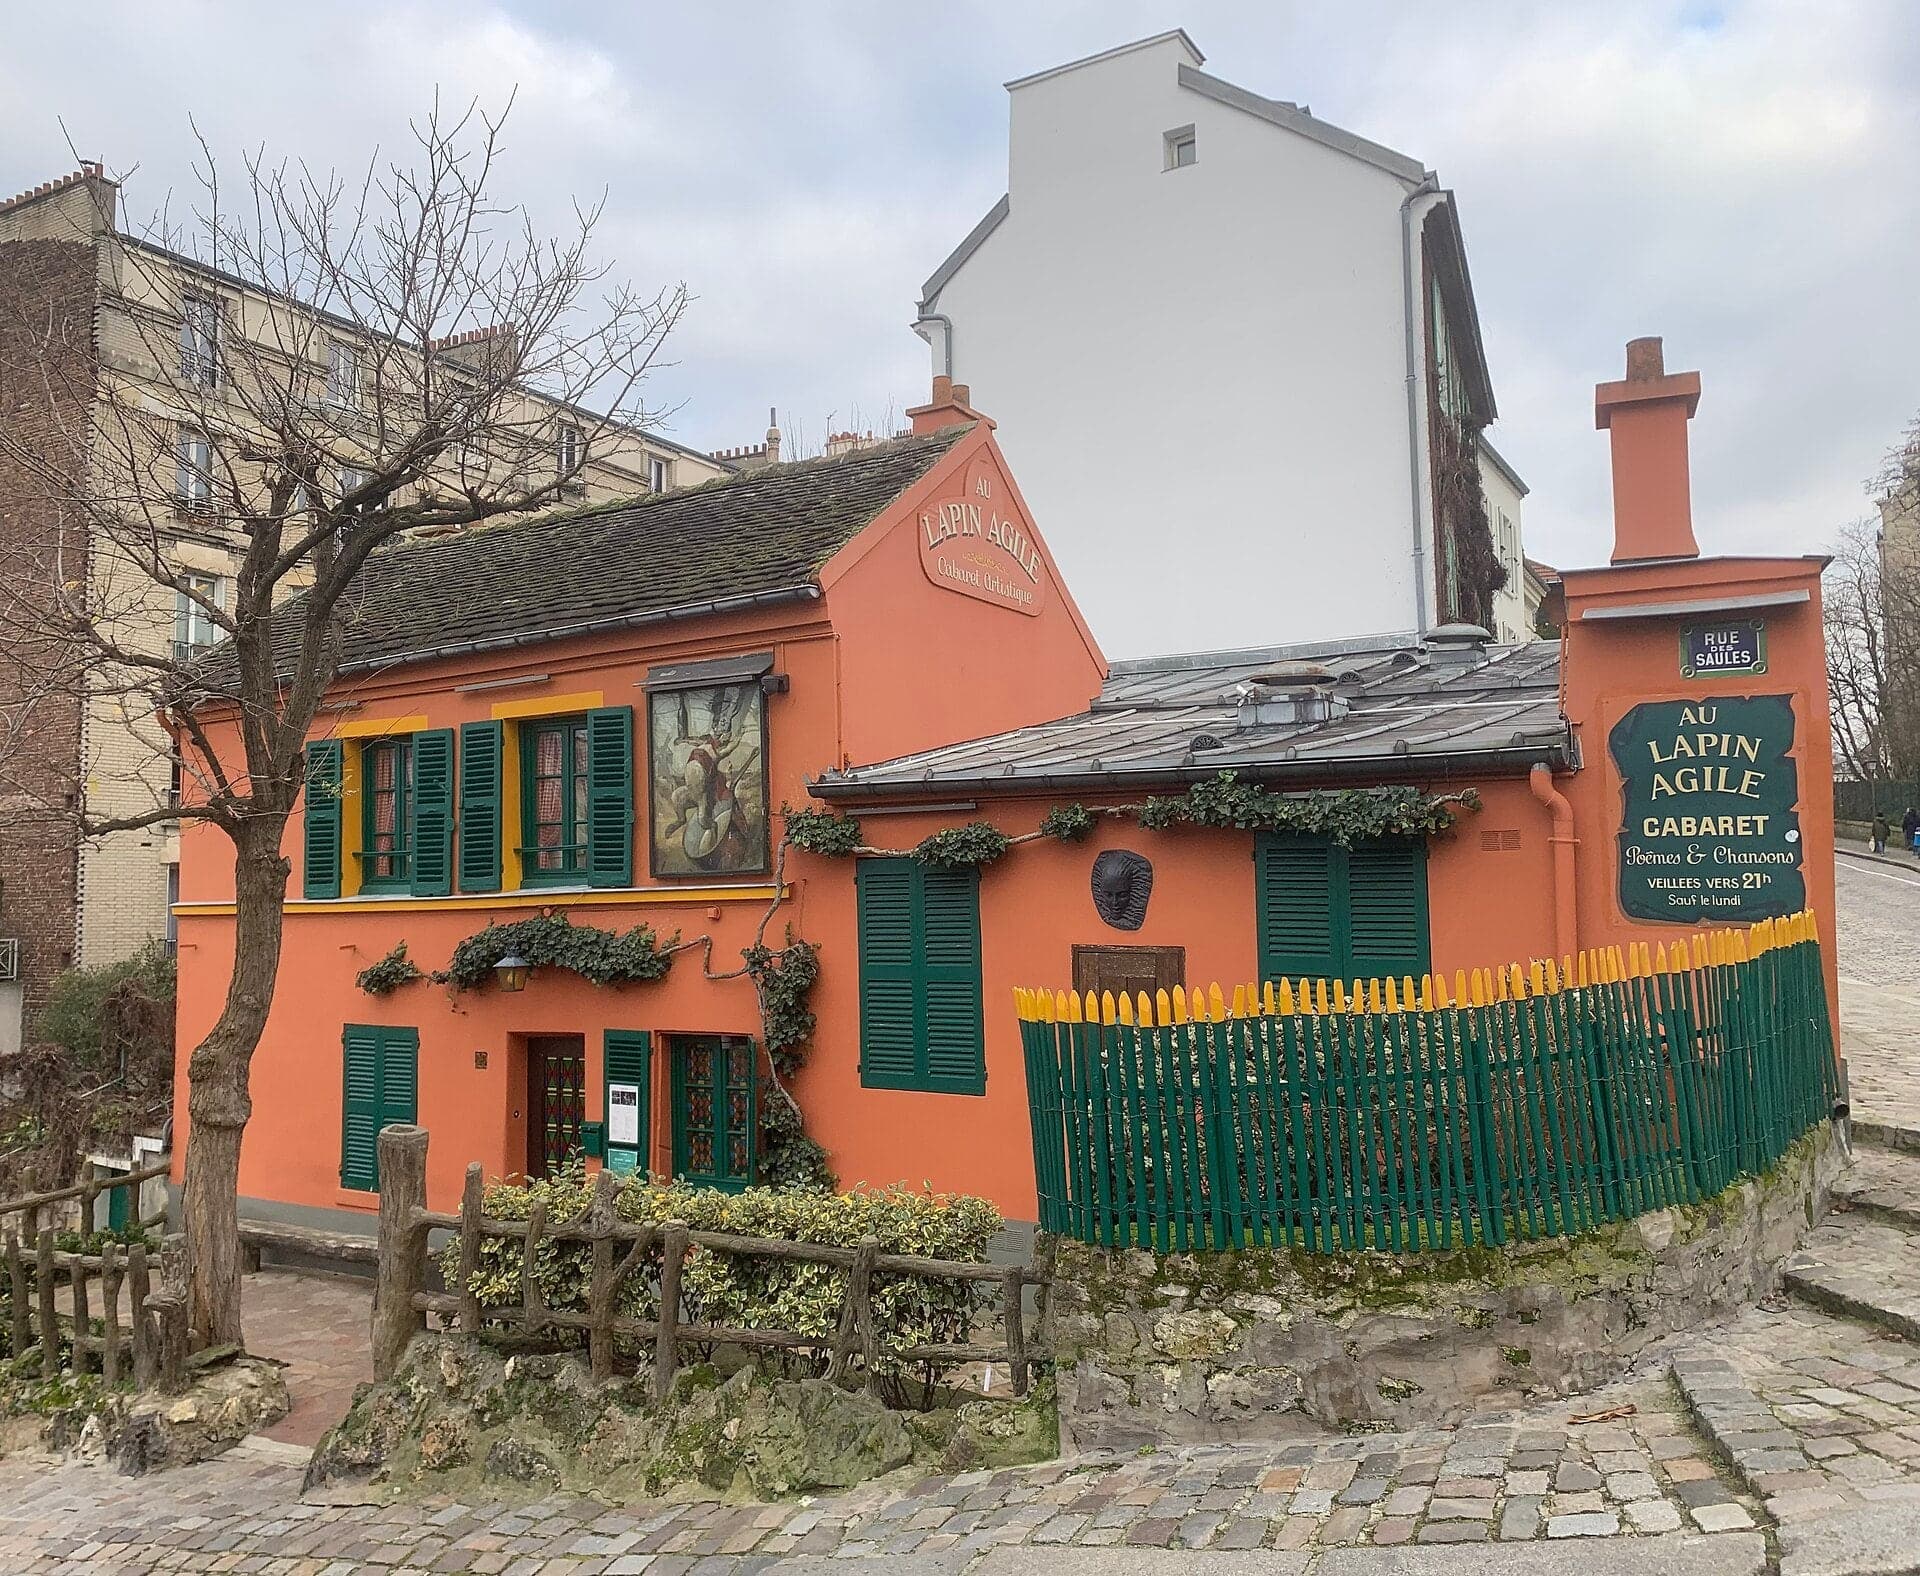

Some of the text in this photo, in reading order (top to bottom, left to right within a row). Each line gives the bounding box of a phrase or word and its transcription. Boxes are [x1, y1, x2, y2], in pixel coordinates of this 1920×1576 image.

[976, 475, 991, 499] AU
[922, 502, 1041, 584] LAPIN AGILE
[937, 556, 981, 587] Cabaret
[1704, 631, 1739, 646] RUE
[1710, 644, 1734, 652] DES
[1695, 650, 1751, 666] SAULES
[1678, 706, 1717, 727] AU
[1647, 733, 1762, 764] LAPIN
[1651, 766, 1766, 801] AGILE
[1643, 815, 1769, 838] CABARET
[1686, 843, 1707, 866] &
[1713, 845, 1794, 865] Chansons
[1647, 872, 1772, 890] VEILLEES VERS 21h
[1668, 893, 1741, 906] Sauf le lundi
